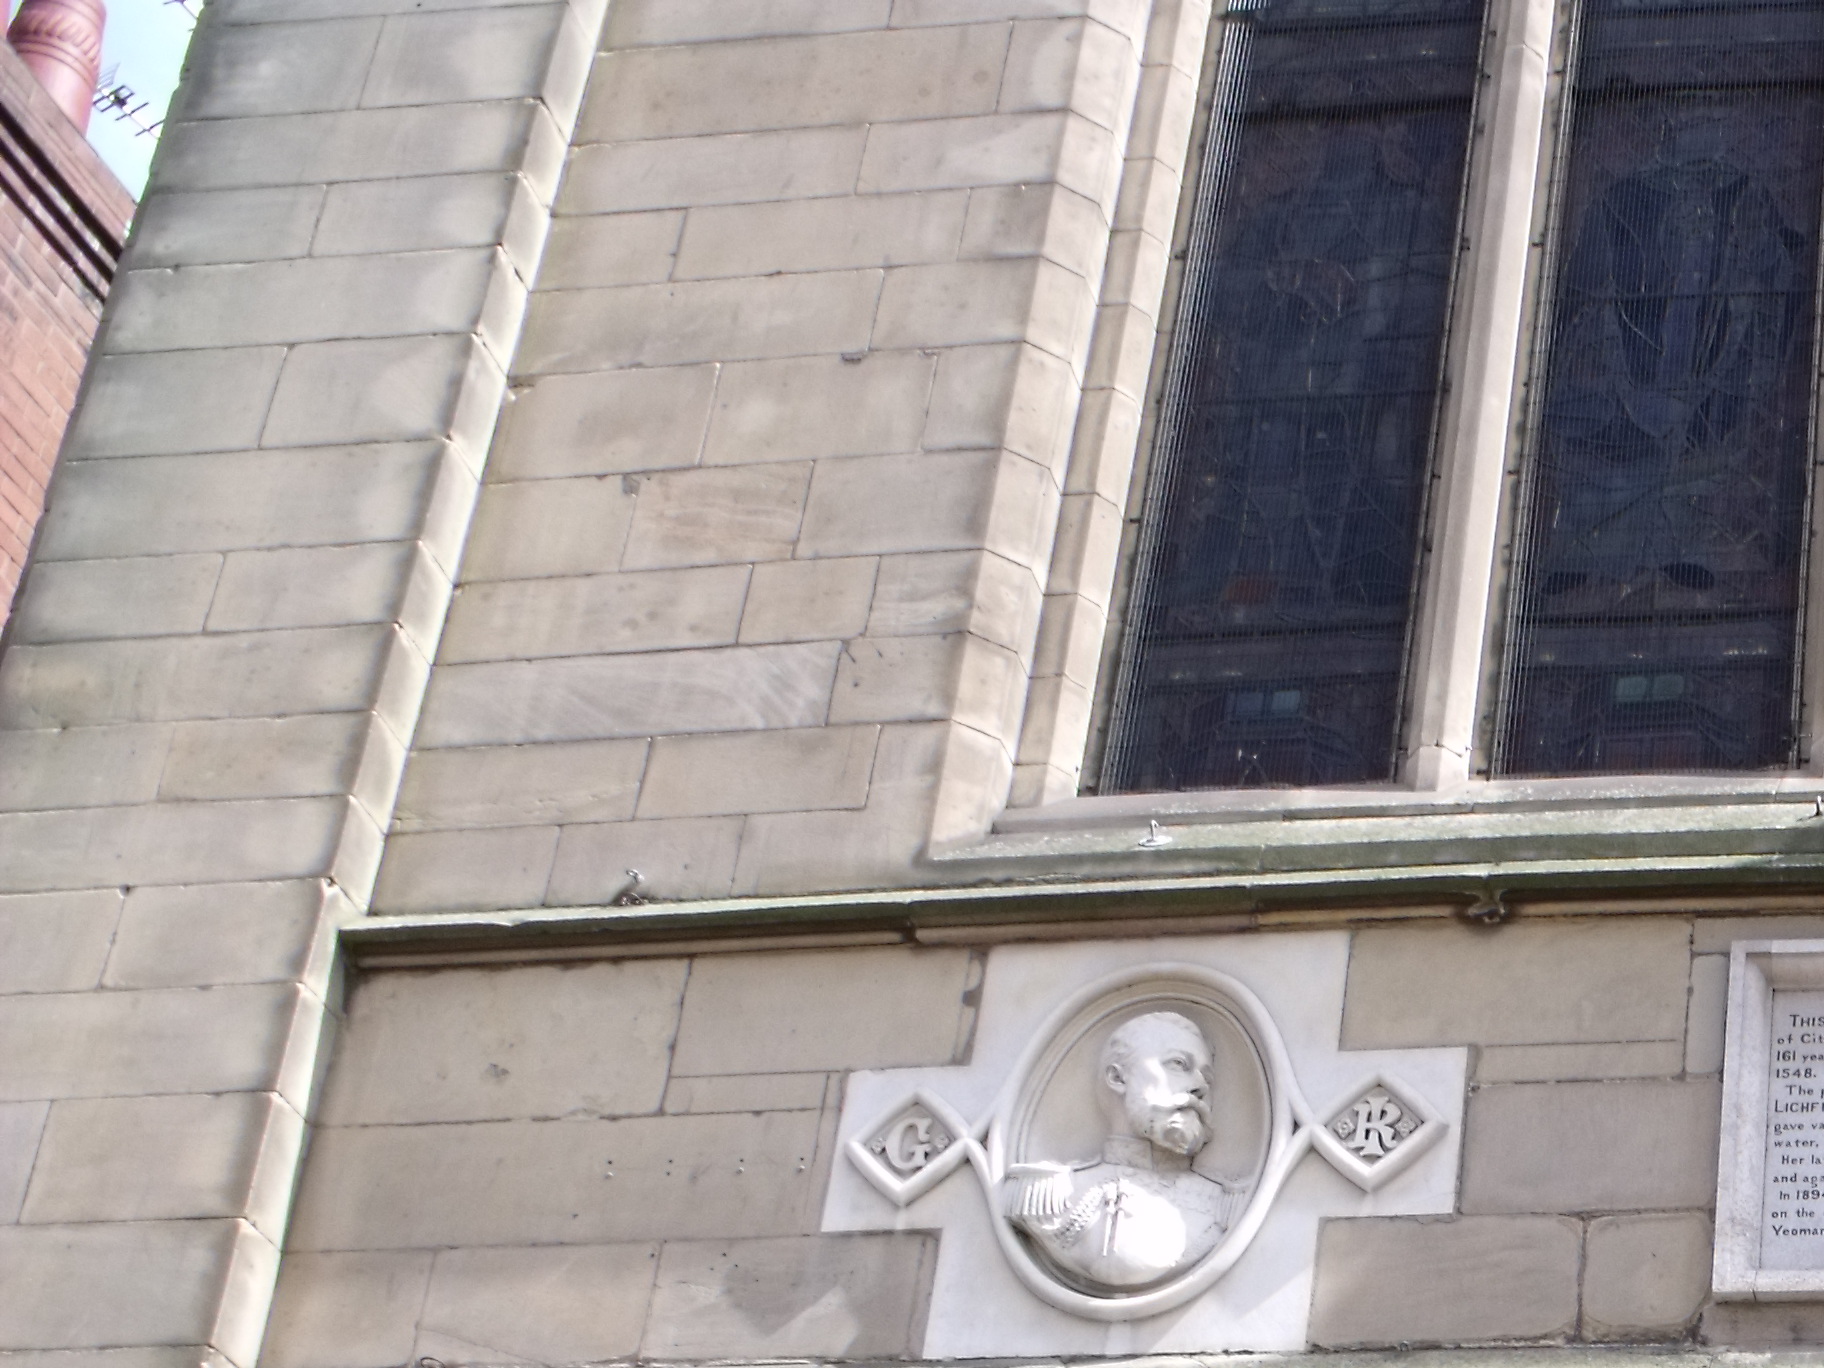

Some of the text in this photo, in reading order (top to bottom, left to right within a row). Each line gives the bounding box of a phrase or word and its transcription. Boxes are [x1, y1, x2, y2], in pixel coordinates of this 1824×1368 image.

[1777, 1032, 1793, 1044] of
[1776, 1050, 1796, 1061] 161
[1776, 1068, 1817, 1079] 1548.
[1785, 1084, 1814, 1096] The
[1774, 1122, 1805, 1134] gave
[1781, 1154, 1805, 1166] Her
[1772, 1172, 1797, 1183] and
[1779, 1190, 1790, 1200] In
[1771, 1209, 1788, 1218] on
[1795, 1207, 1815, 1218] the
